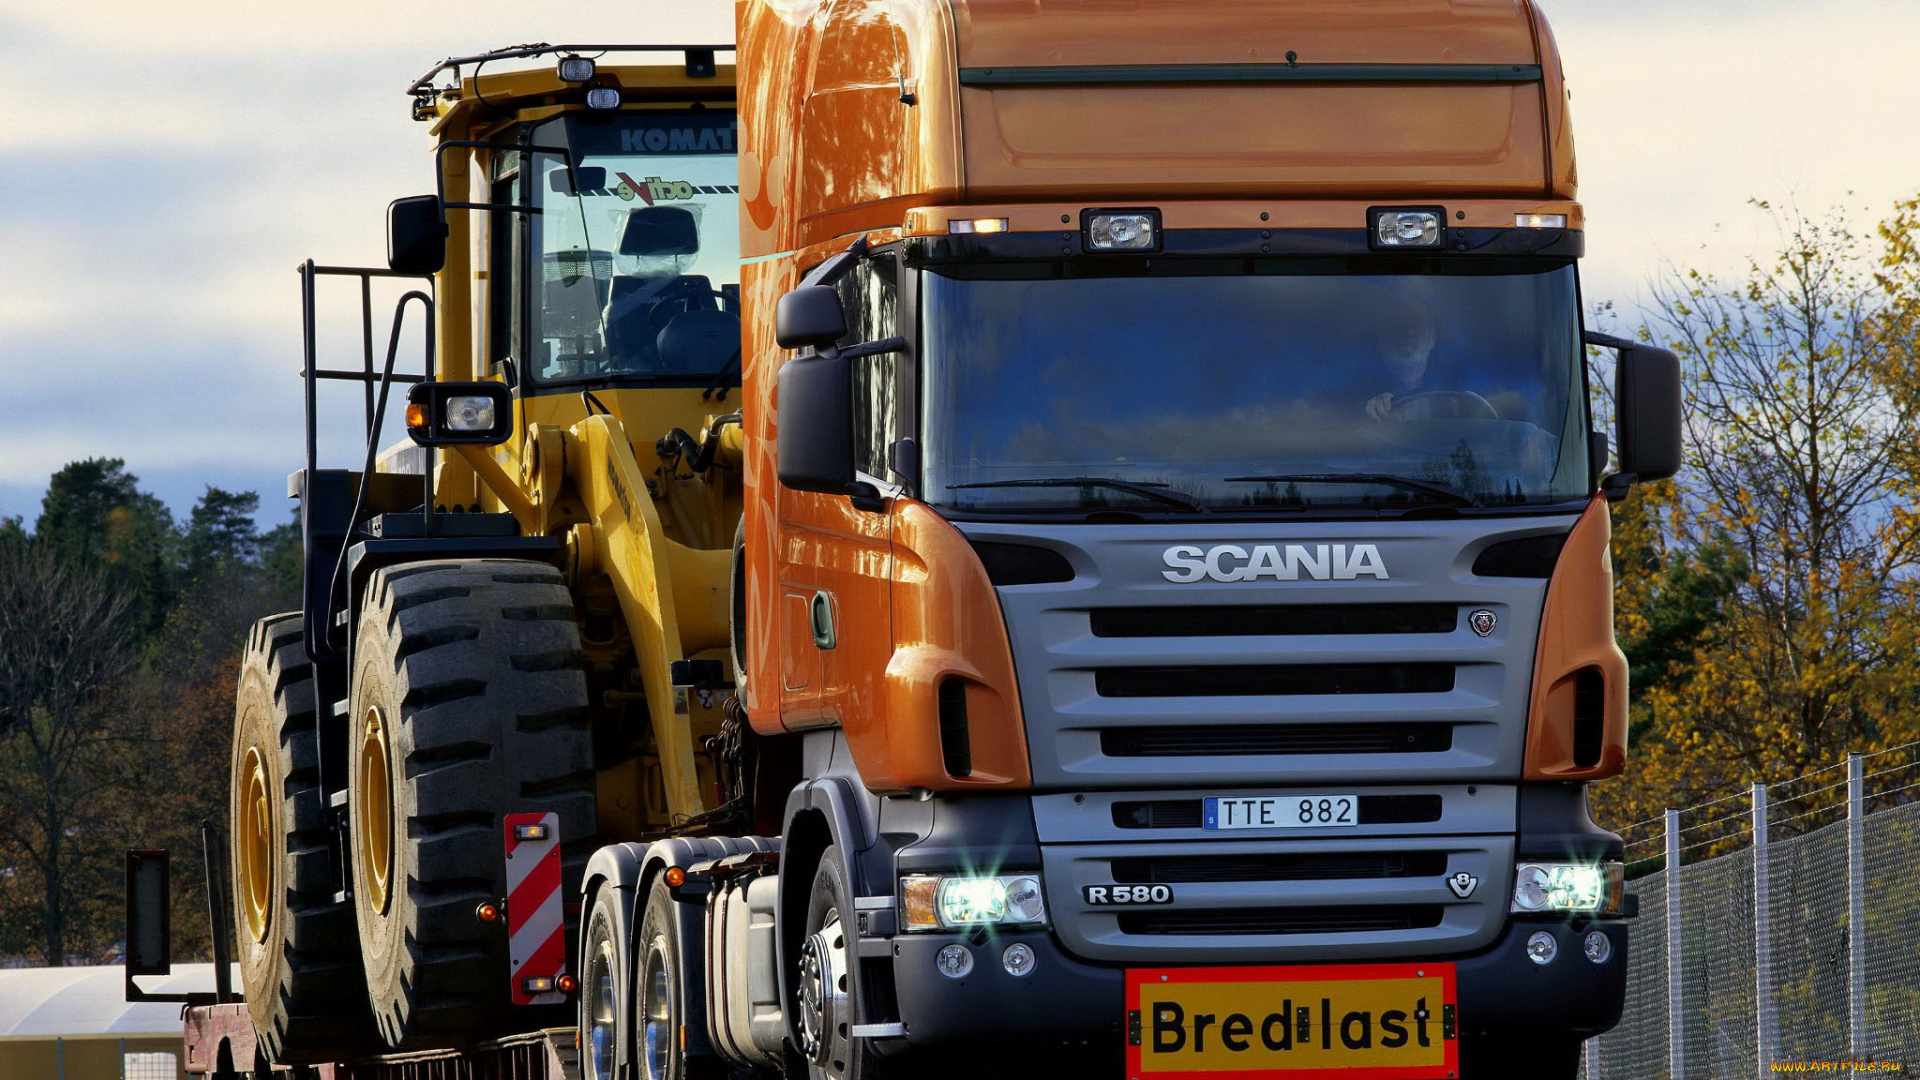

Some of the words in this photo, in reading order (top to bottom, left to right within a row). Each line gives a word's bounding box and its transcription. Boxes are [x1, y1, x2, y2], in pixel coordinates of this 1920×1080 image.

[1161, 543, 1390, 583] SCANIA
[1222, 800, 1275, 825] TTE
[1298, 798, 1351, 824] 882
[1112, 885, 1170, 903] 580
[1152, 999, 1293, 1053] Bred
[1320, 996, 1431, 1050] last
